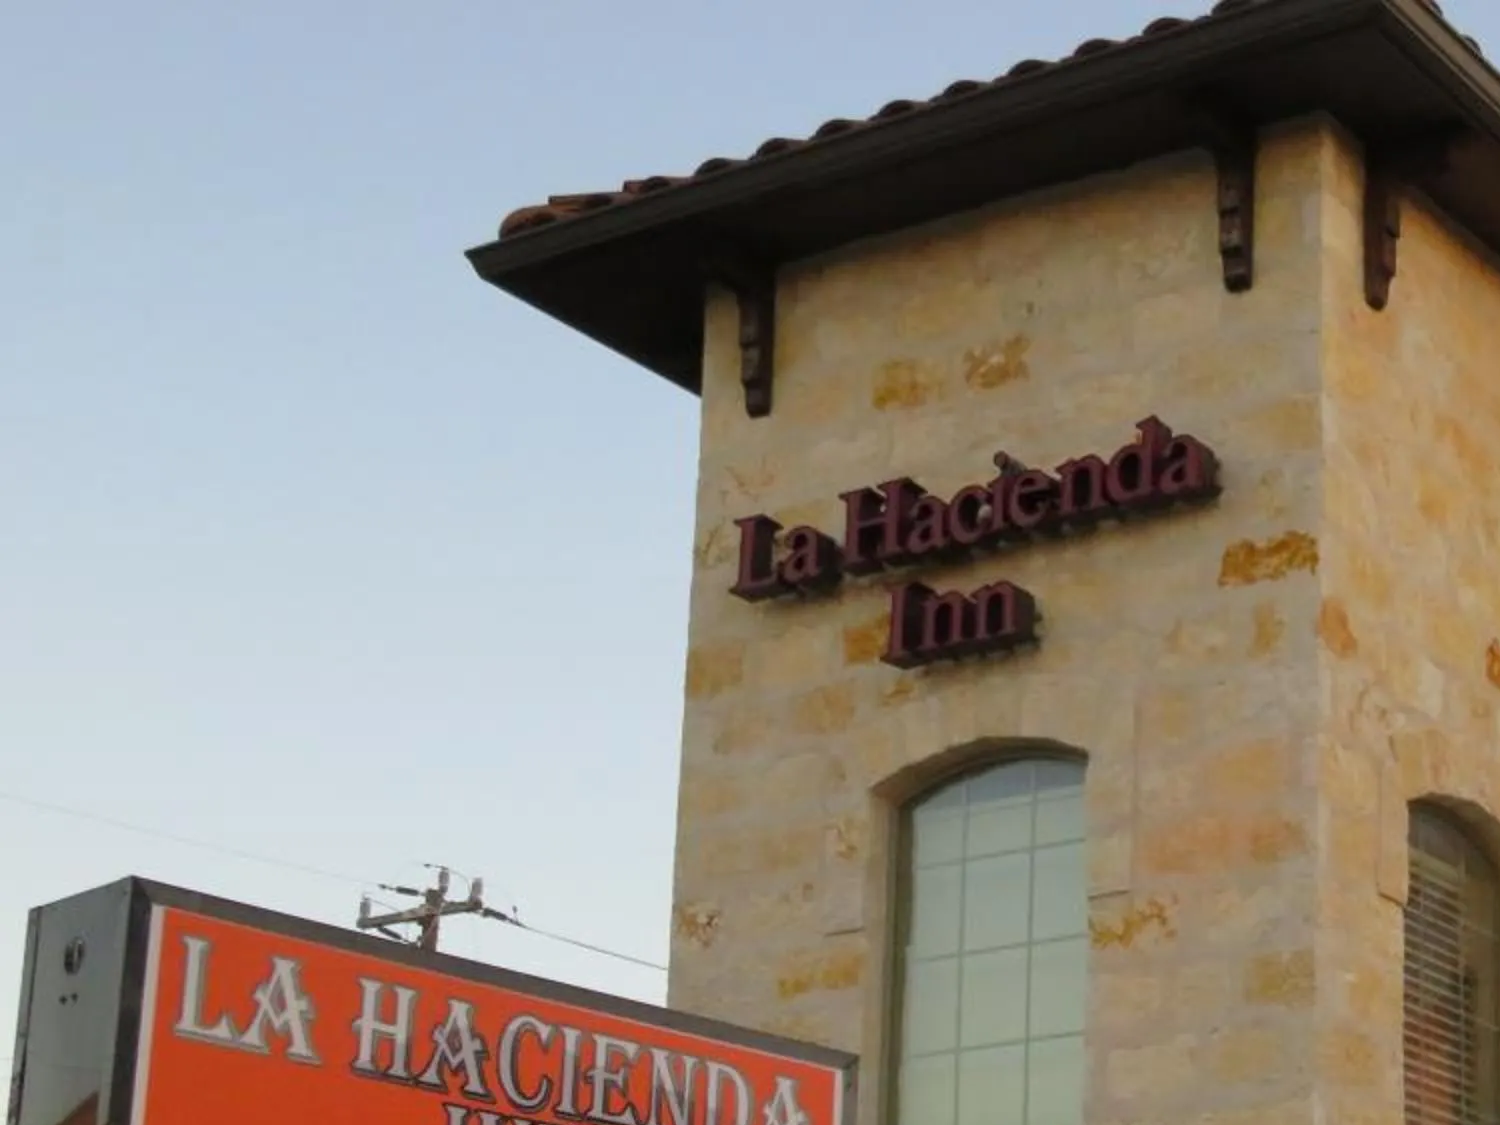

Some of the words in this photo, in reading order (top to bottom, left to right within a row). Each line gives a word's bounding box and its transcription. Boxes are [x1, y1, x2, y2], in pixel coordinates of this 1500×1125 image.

[730, 513, 836, 602] La
[839, 415, 1220, 572] Hacienda
[880, 580, 1039, 668] Inn
[173, 933, 321, 1066] LA
